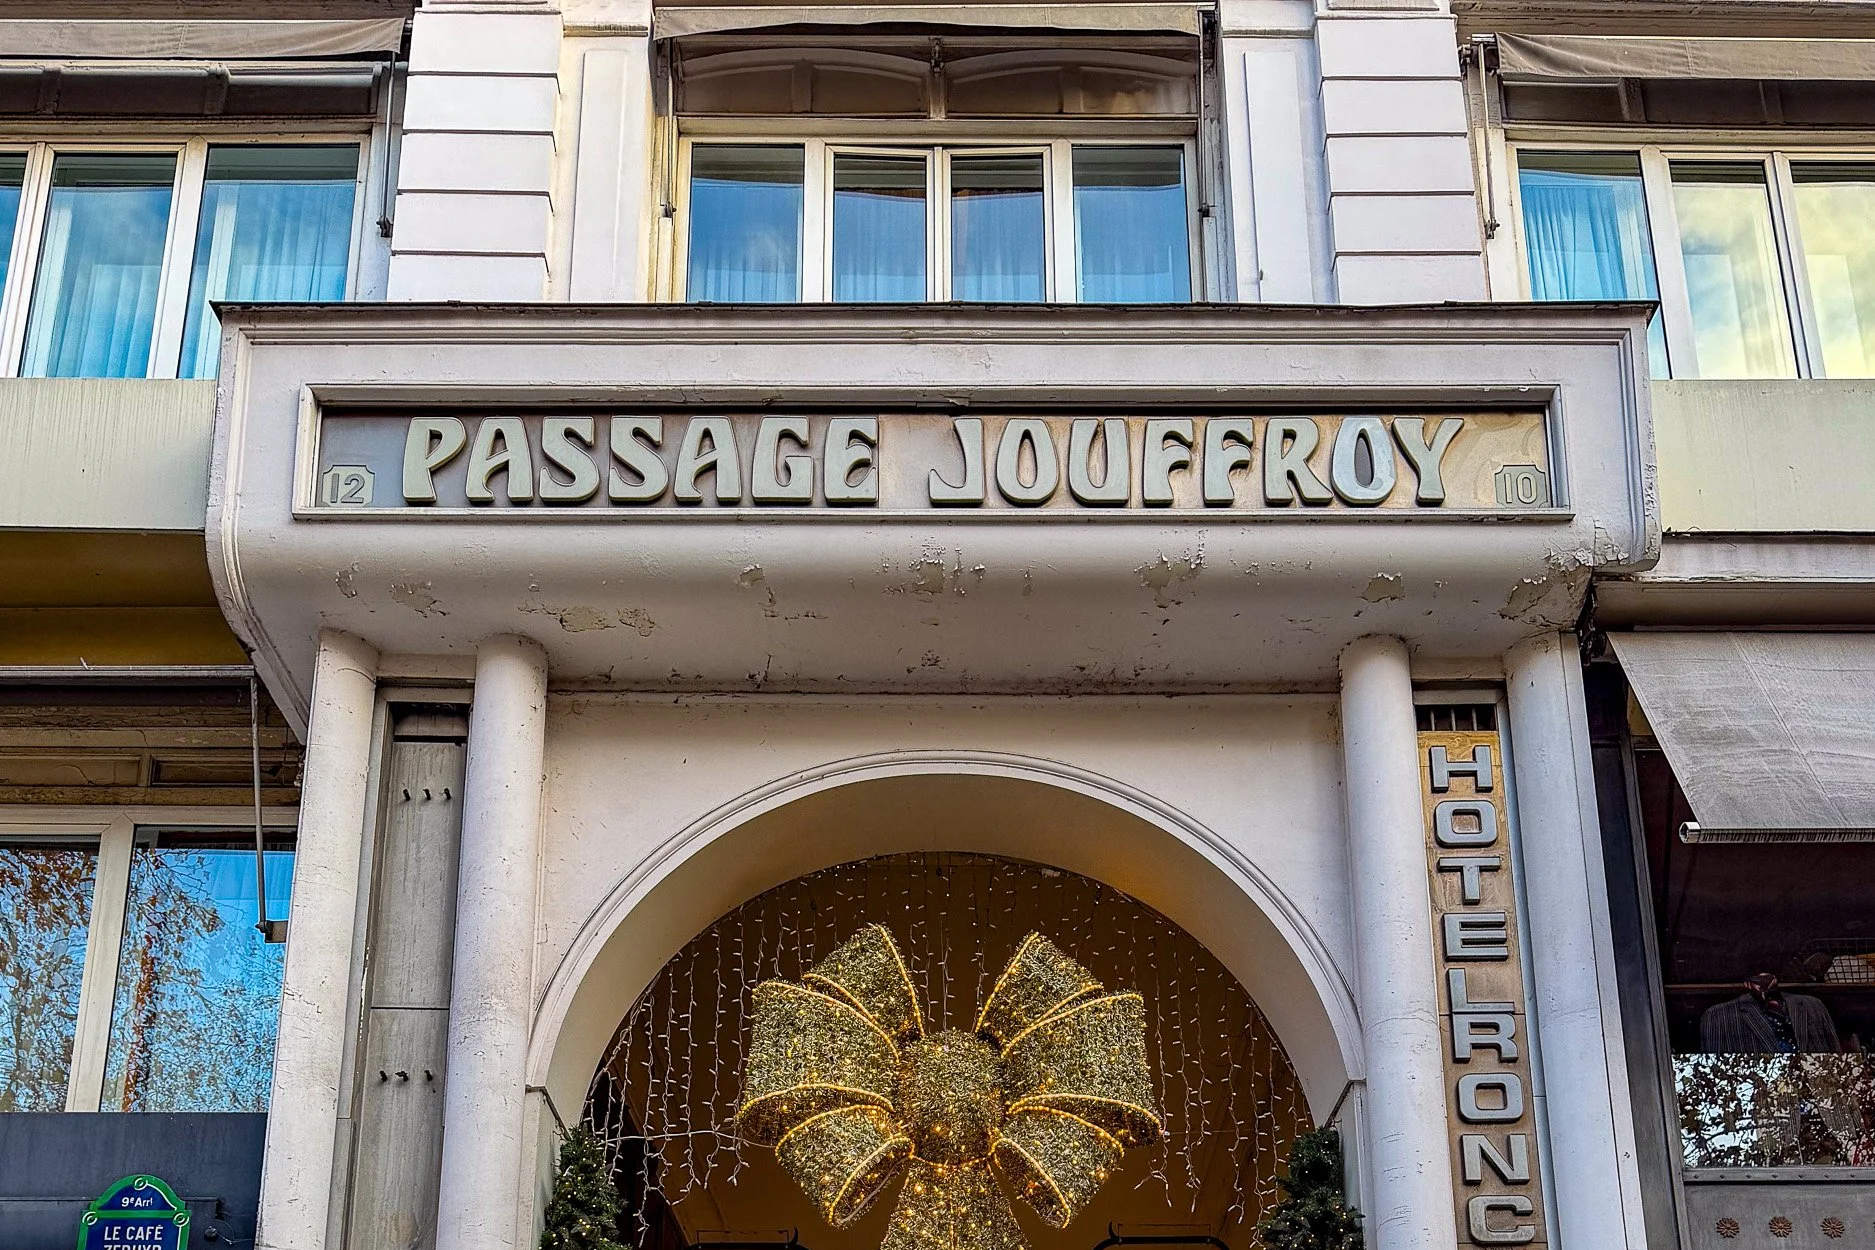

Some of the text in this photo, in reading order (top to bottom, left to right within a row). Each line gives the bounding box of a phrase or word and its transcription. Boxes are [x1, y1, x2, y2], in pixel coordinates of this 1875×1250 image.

[402, 415, 1465, 507] PASSAGE JOUFFROY
[328, 473, 365, 504] 12
[1503, 469, 1537, 504] 10
[1429, 744, 1517, 1012] HOTEL
[104, 1224, 164, 1241] LE CAFÉ
